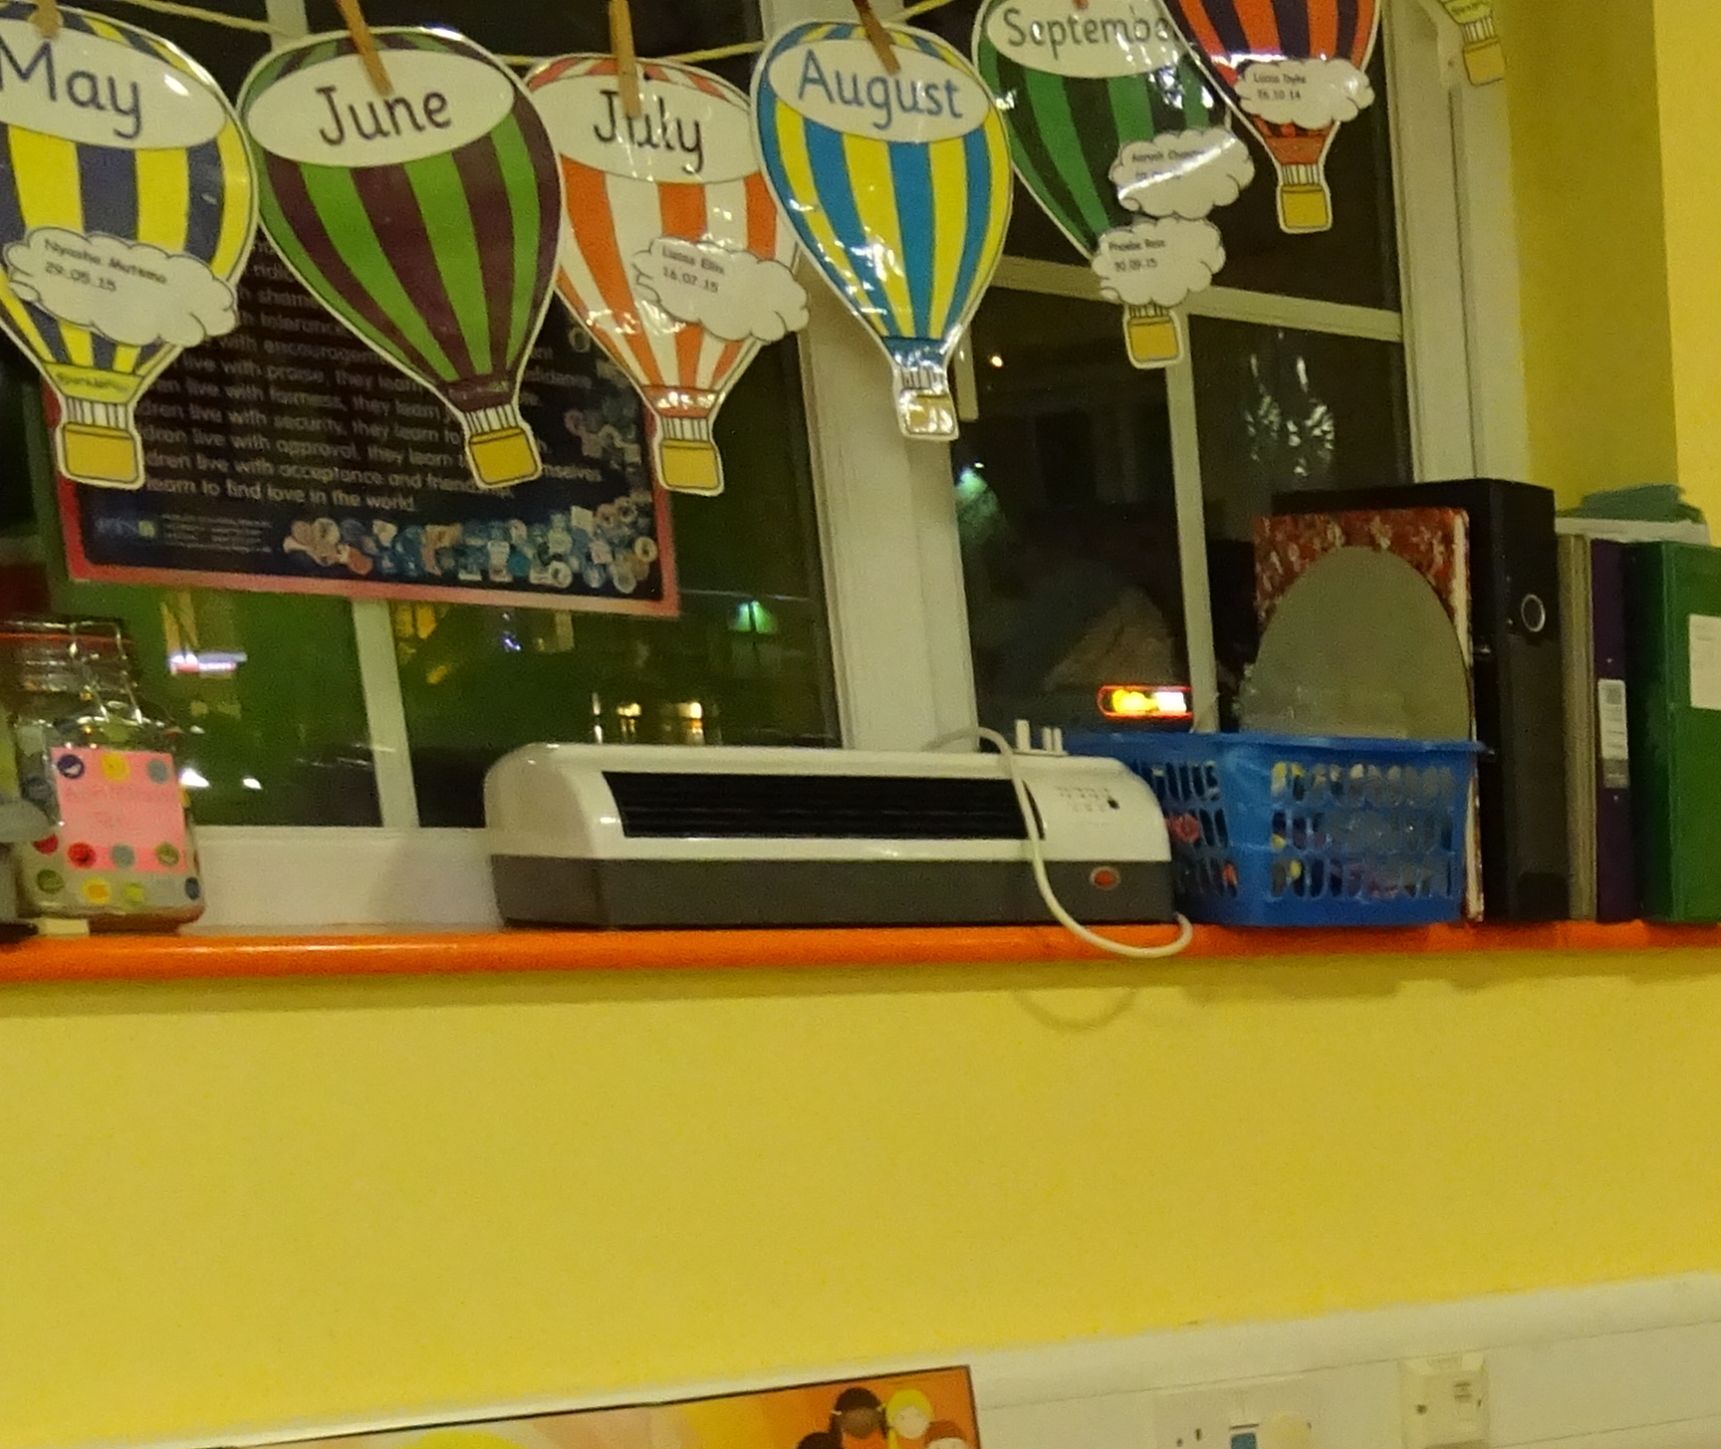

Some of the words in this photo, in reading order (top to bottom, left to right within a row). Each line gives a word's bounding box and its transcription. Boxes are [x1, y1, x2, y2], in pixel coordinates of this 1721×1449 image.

[1003, 6, 1169, 60] Septembe
[0, 36, 142, 139] May
[318, 85, 452, 148] June
[799, 49, 963, 131] August
[593, 88, 705, 173] July
[201, 479, 221, 495] to
[224, 477, 262, 499] find
[265, 484, 306, 503] love
[308, 488, 328, 505] in
[331, 490, 362, 507] the
